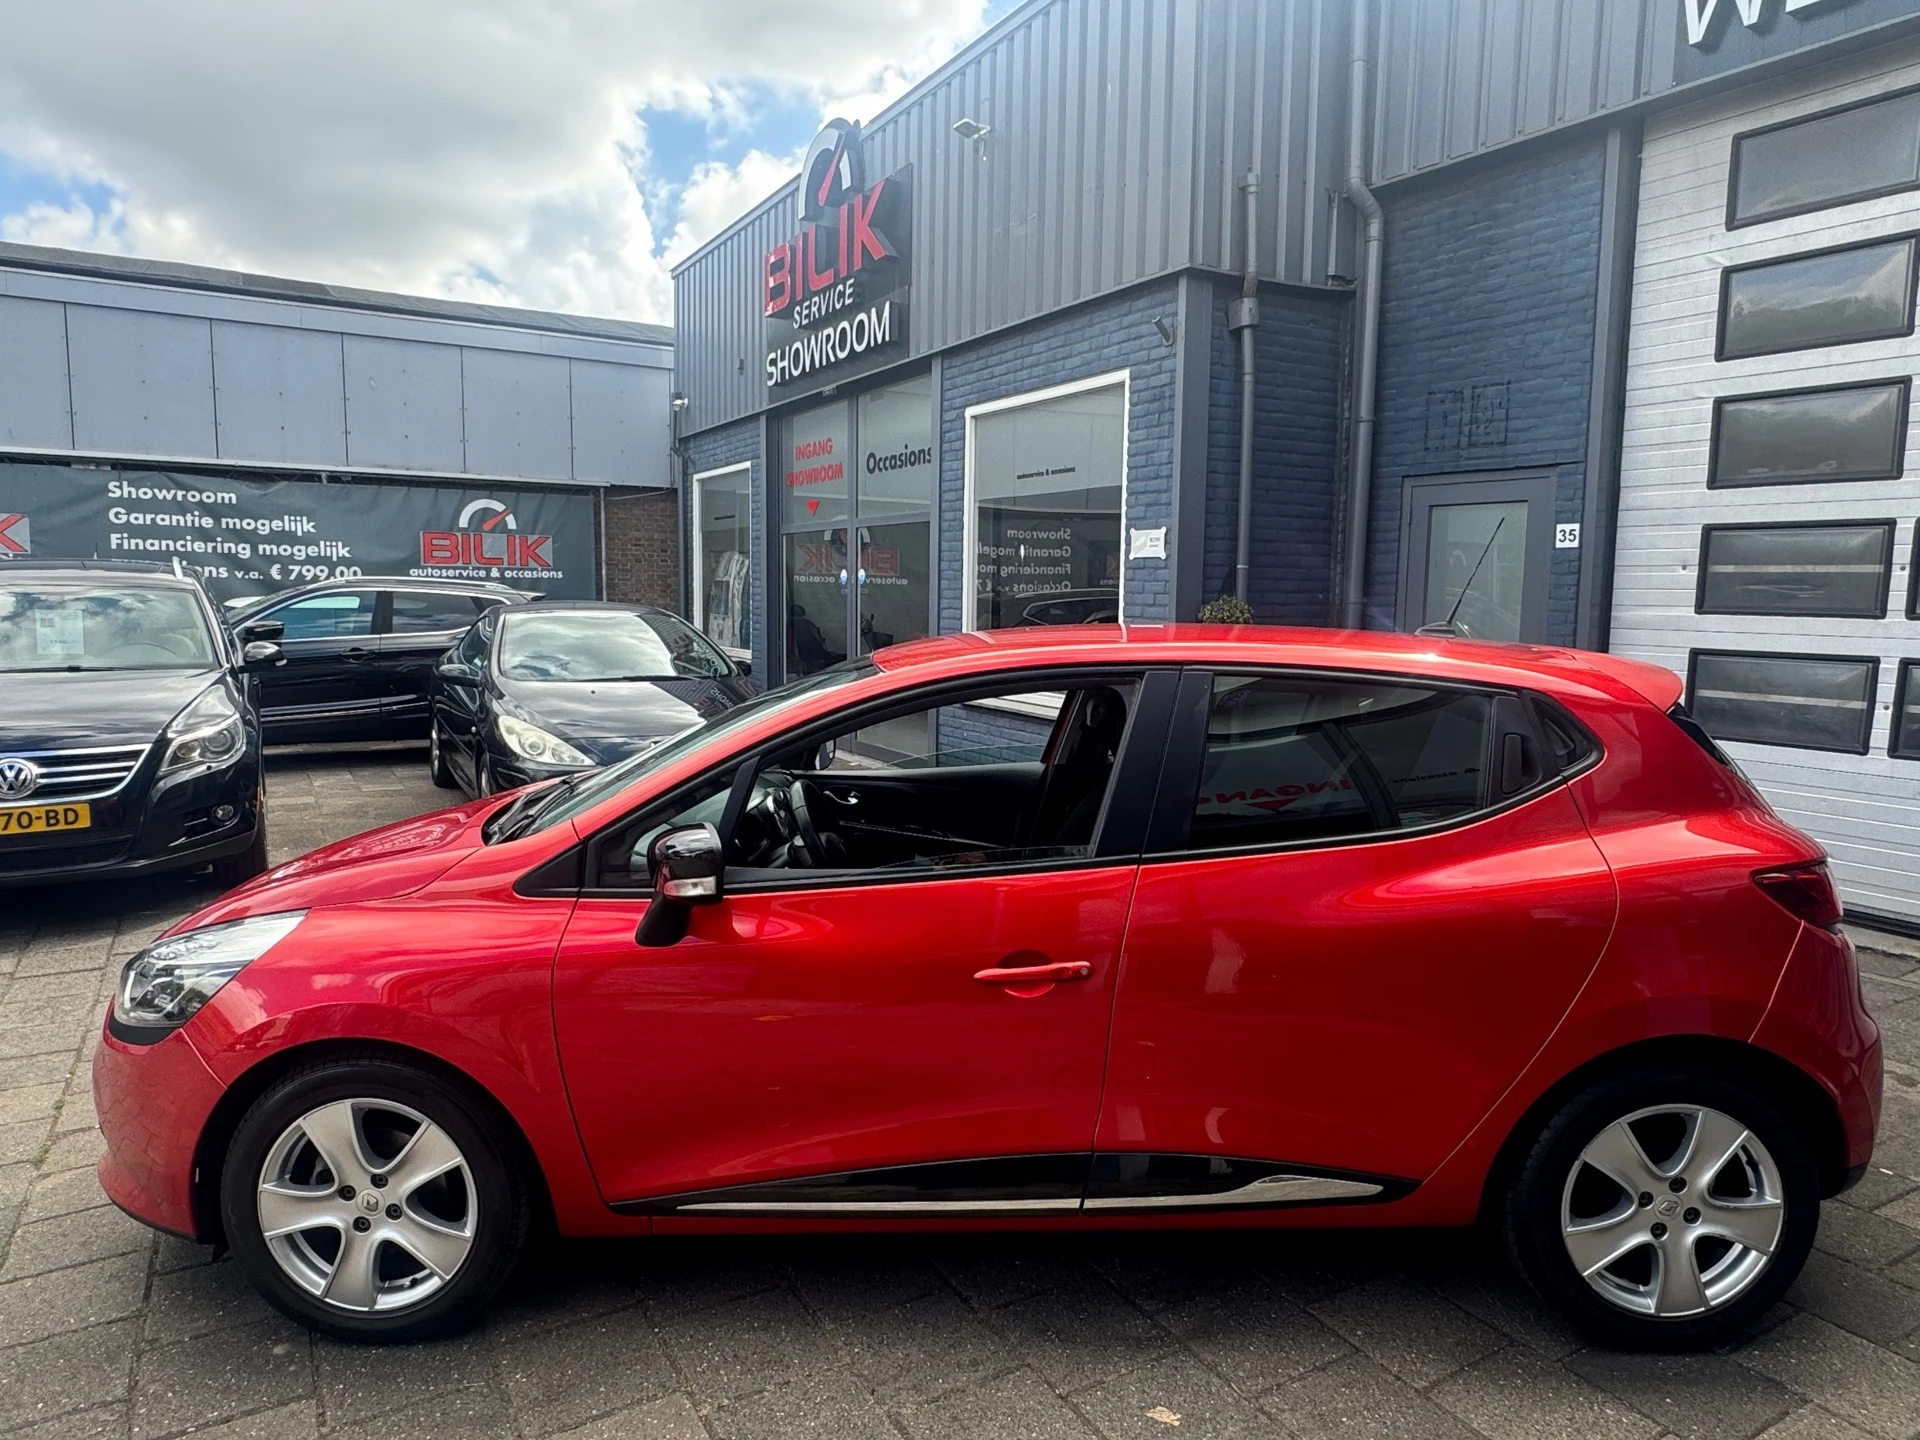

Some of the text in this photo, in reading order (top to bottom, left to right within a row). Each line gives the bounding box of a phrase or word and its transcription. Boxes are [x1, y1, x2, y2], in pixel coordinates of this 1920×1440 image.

[764, 179, 887, 317] BILIK
[793, 278, 855, 330] SERVICE
[766, 300, 891, 387] SHOWROOM
[795, 437, 833, 462] INGANG
[866, 443, 932, 475] Occasions
[786, 462, 844, 488] SHOWROOM
[107, 480, 237, 505] Showroom
[108, 507, 317, 537] Garantie mogelijk
[1558, 528, 1577, 543] 35
[110, 533, 352, 562] Financiering mogelijk
[422, 531, 552, 568] BILIK
[234, 564, 363, 582] v.a. € 799,00
[410, 567, 564, 579] autoservice & occasions
